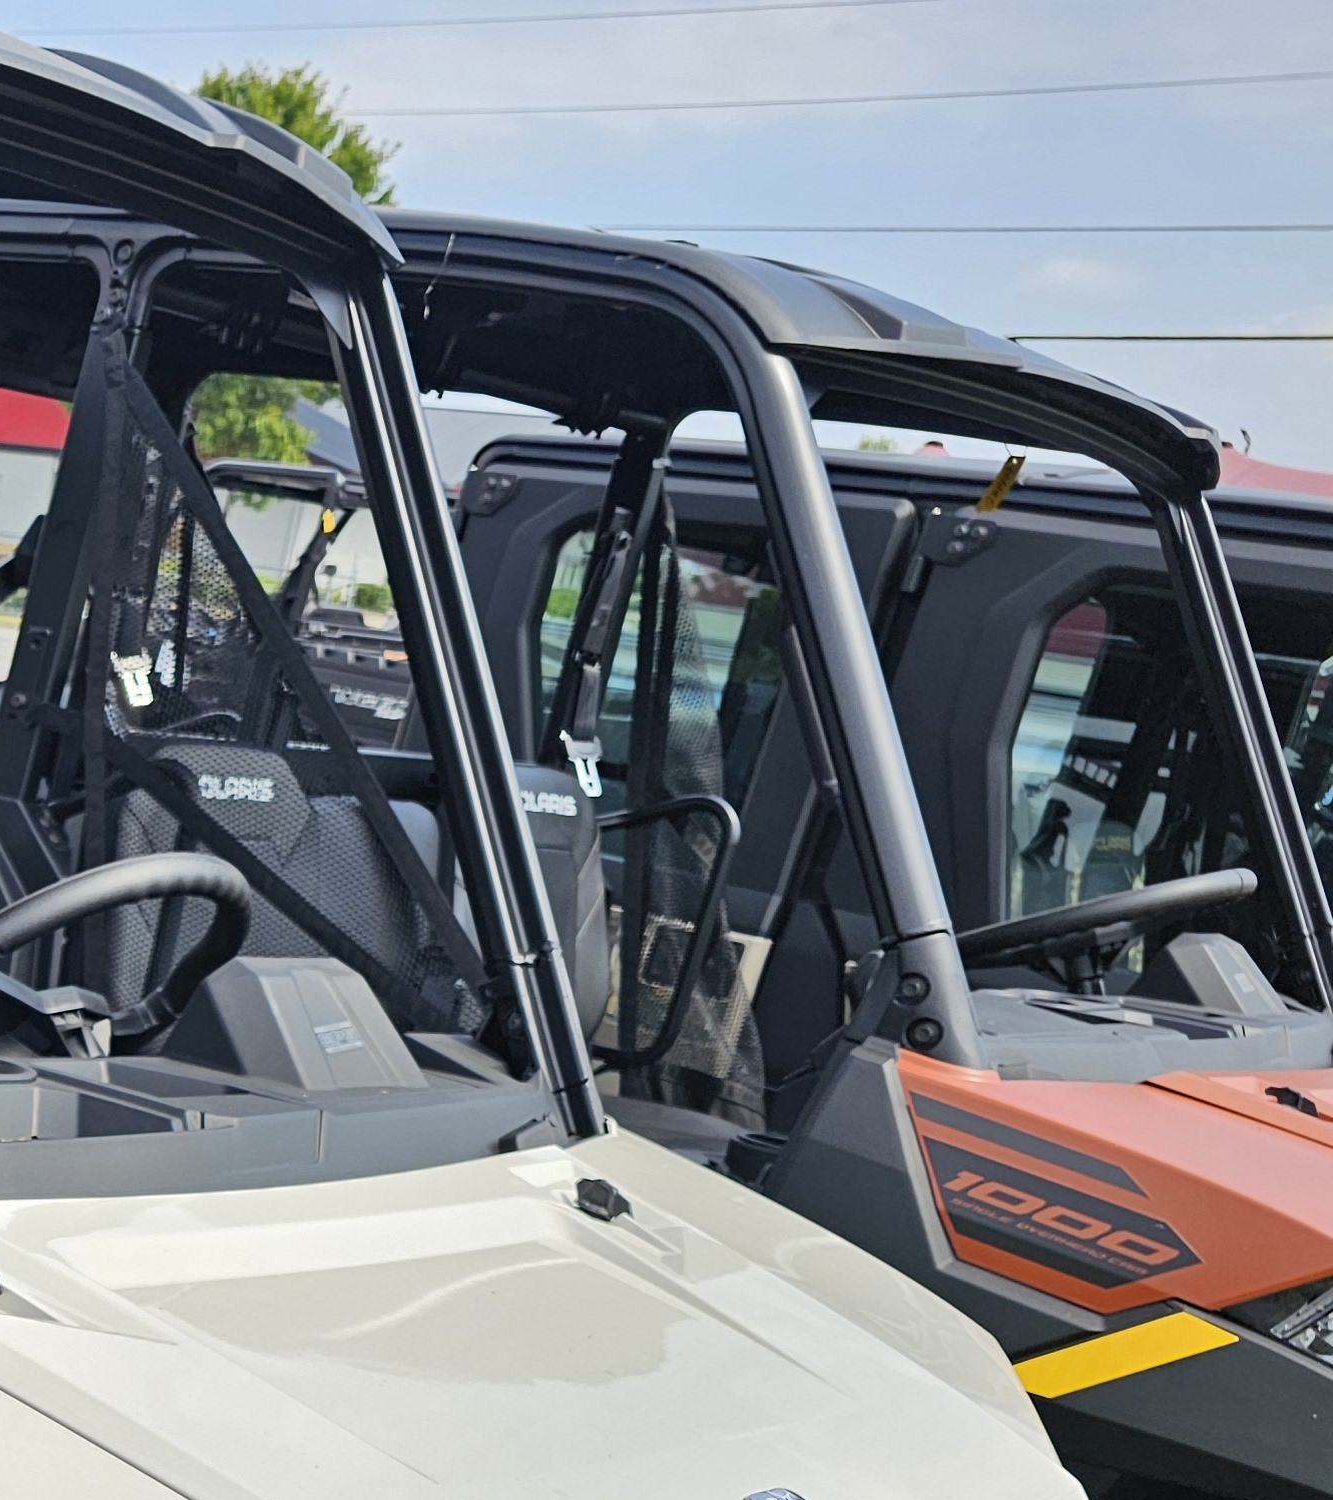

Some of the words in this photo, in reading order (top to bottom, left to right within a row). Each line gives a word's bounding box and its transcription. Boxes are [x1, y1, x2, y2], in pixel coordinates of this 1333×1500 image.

[198, 774, 275, 802] OLARIS
[520, 790, 577, 816] OLARIS
[943, 1170, 1180, 1265] 1000
